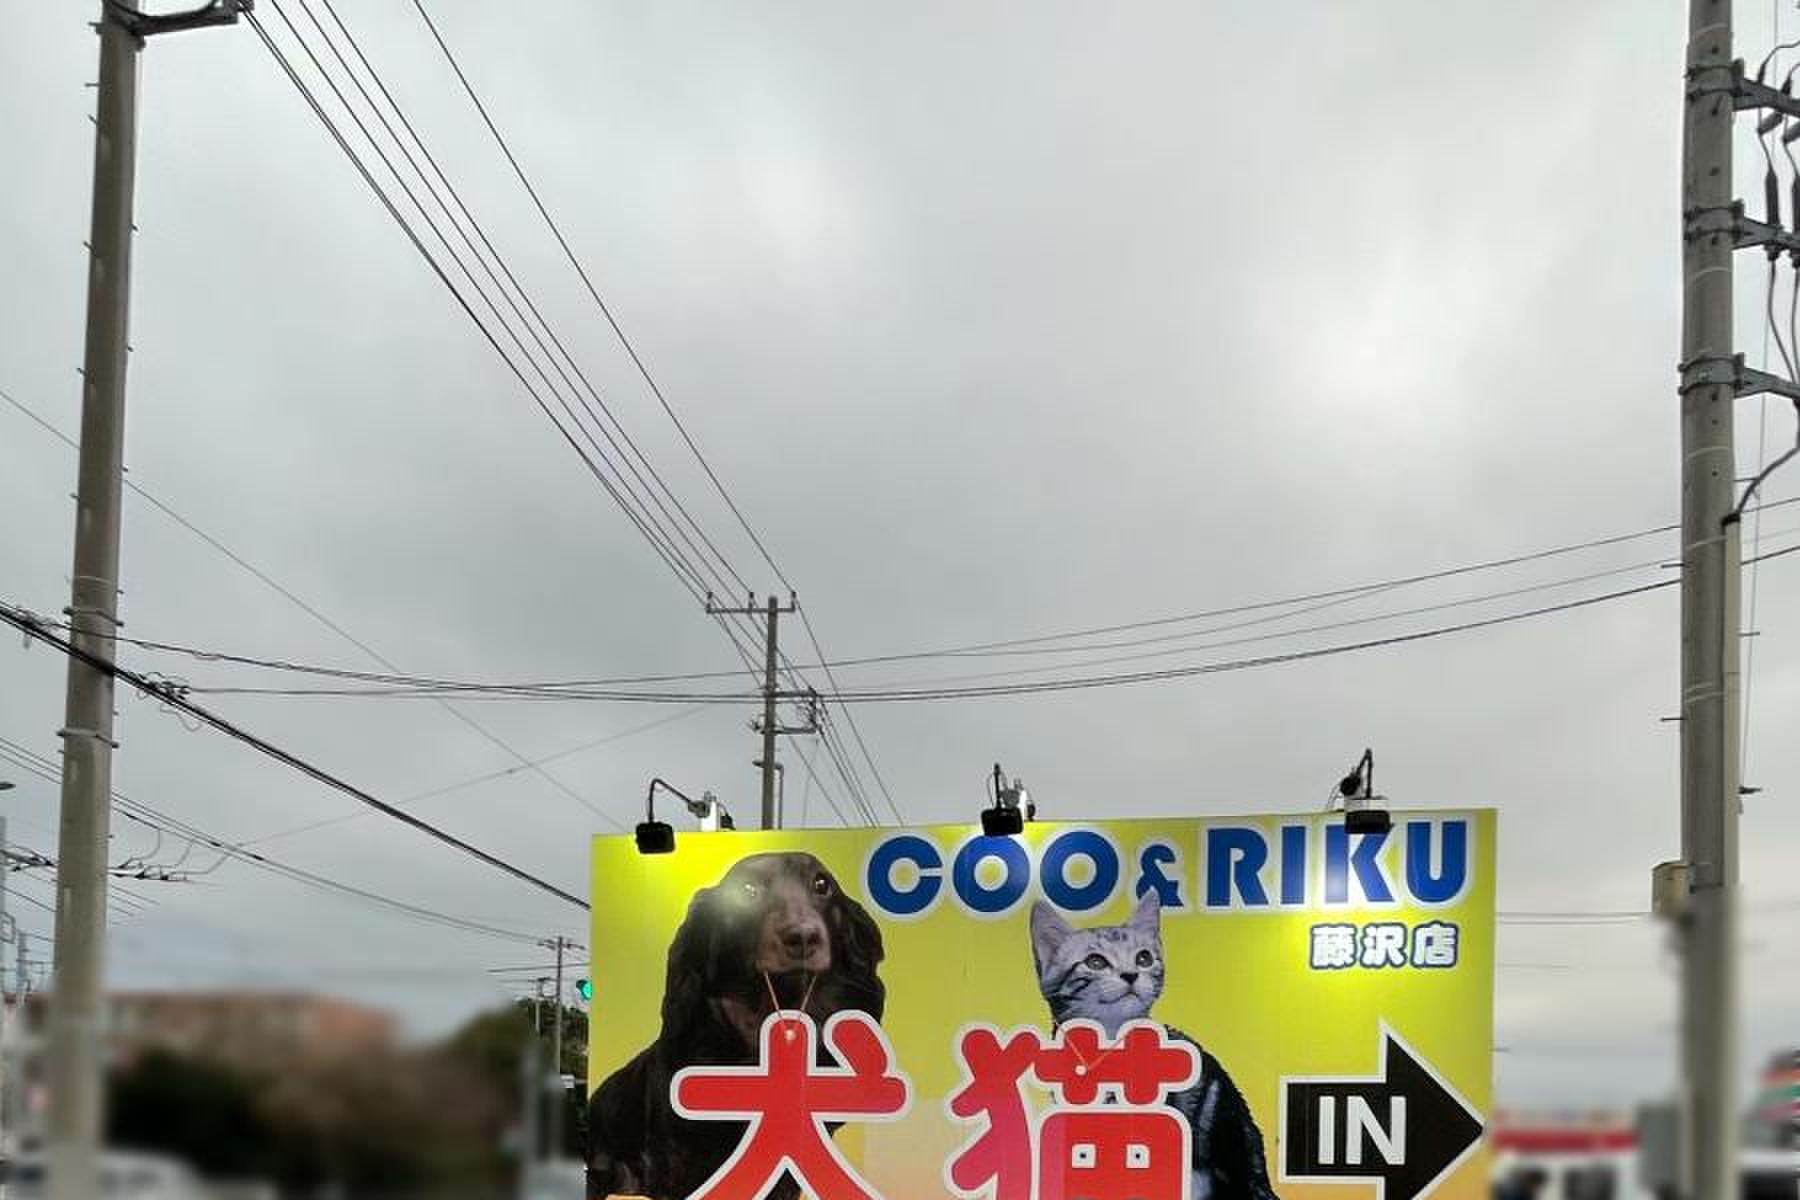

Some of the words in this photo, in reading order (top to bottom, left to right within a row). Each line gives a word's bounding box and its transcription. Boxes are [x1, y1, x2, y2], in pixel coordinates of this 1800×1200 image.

[1310, 920, 1460, 970] 藤沢店
[1317, 1095, 1408, 1166] IN
